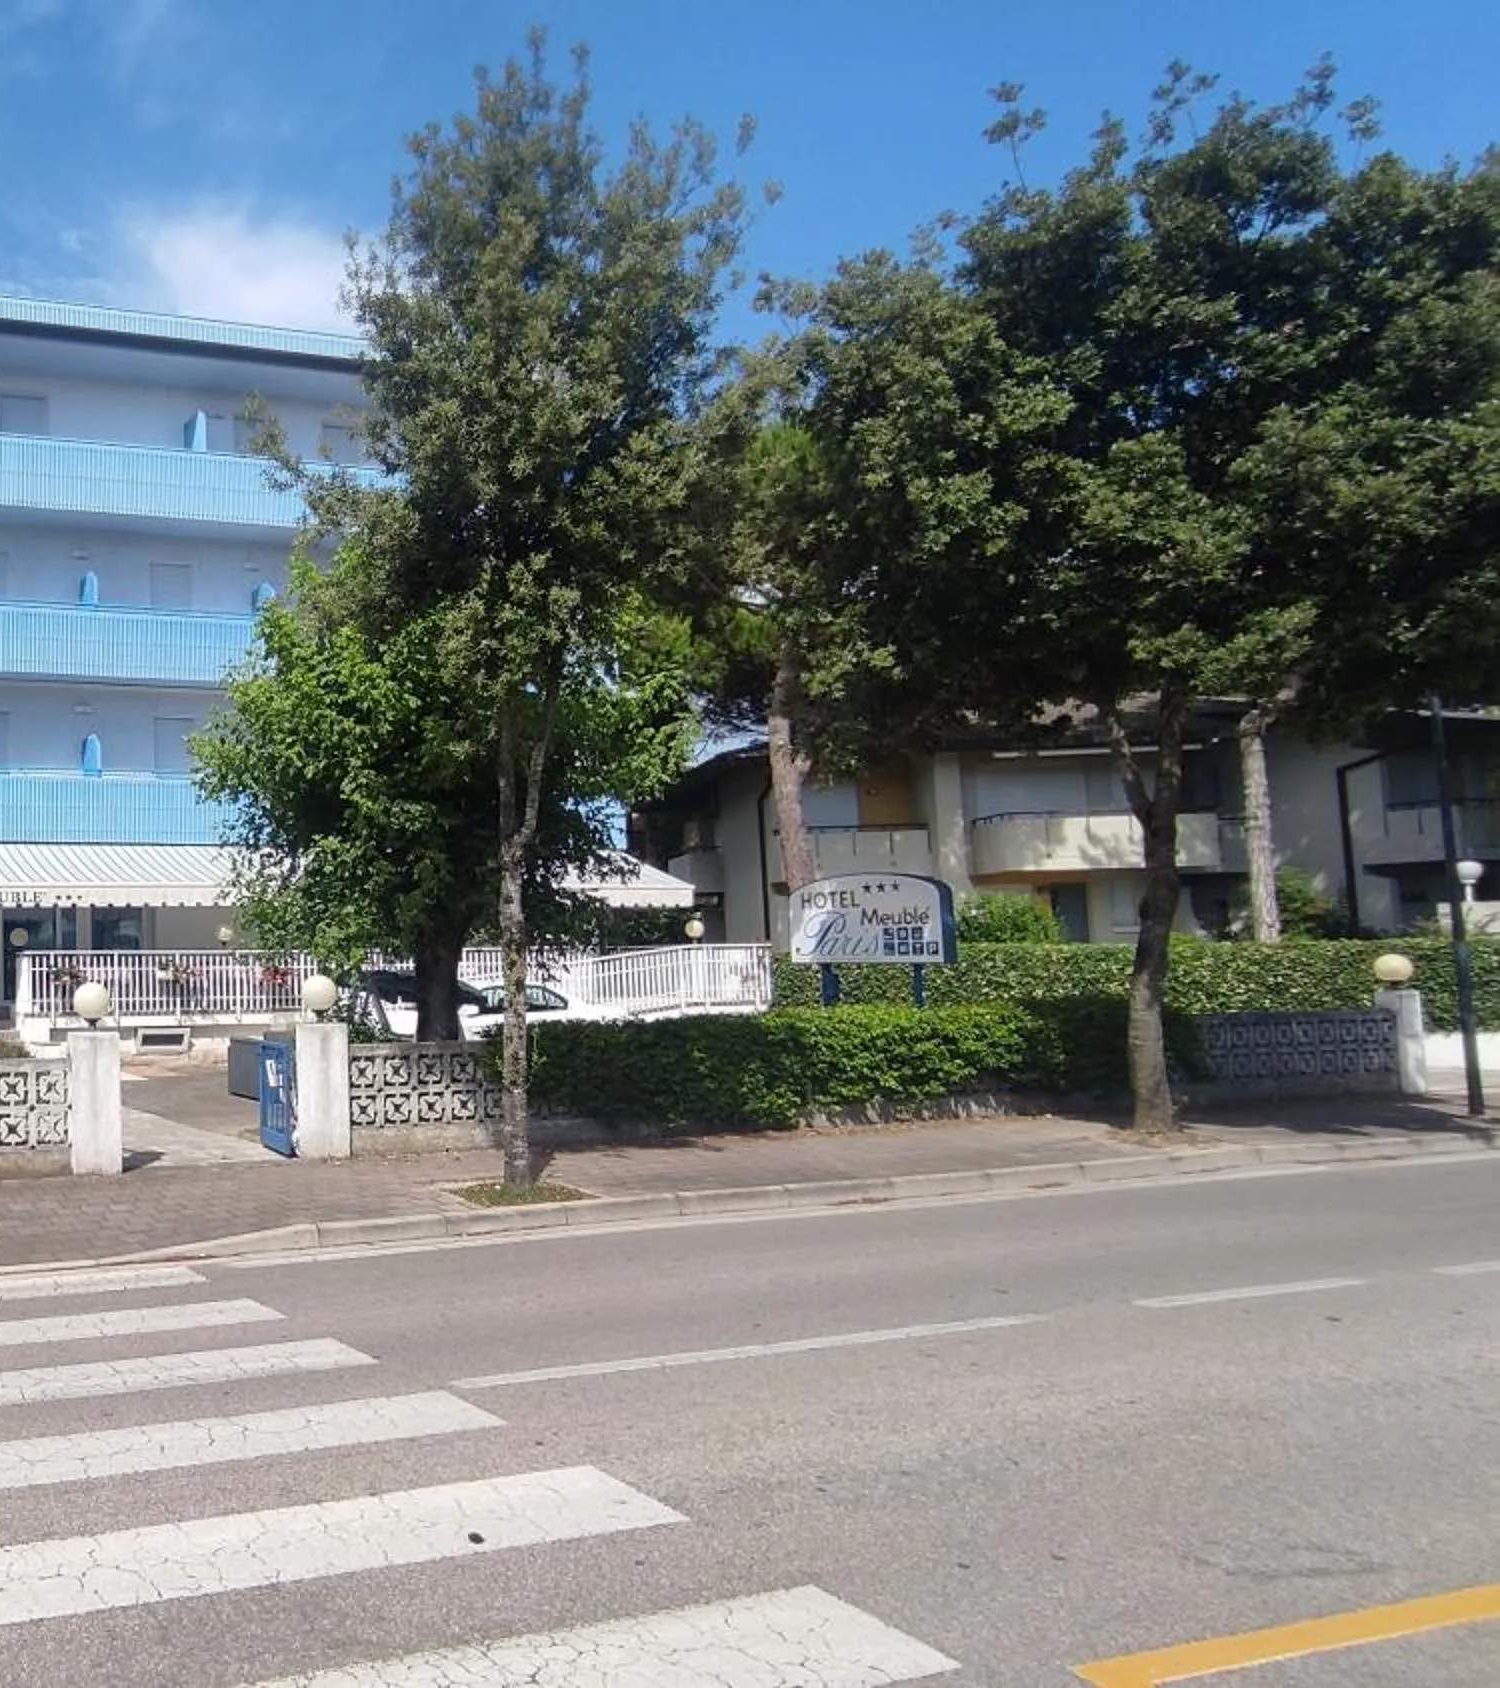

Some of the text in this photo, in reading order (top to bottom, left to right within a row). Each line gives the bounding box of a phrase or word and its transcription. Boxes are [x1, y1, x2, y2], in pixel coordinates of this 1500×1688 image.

[801, 889, 861, 909] HOTEL
[860, 906, 930, 926] Meublé
[798, 910, 879, 957] Paris
